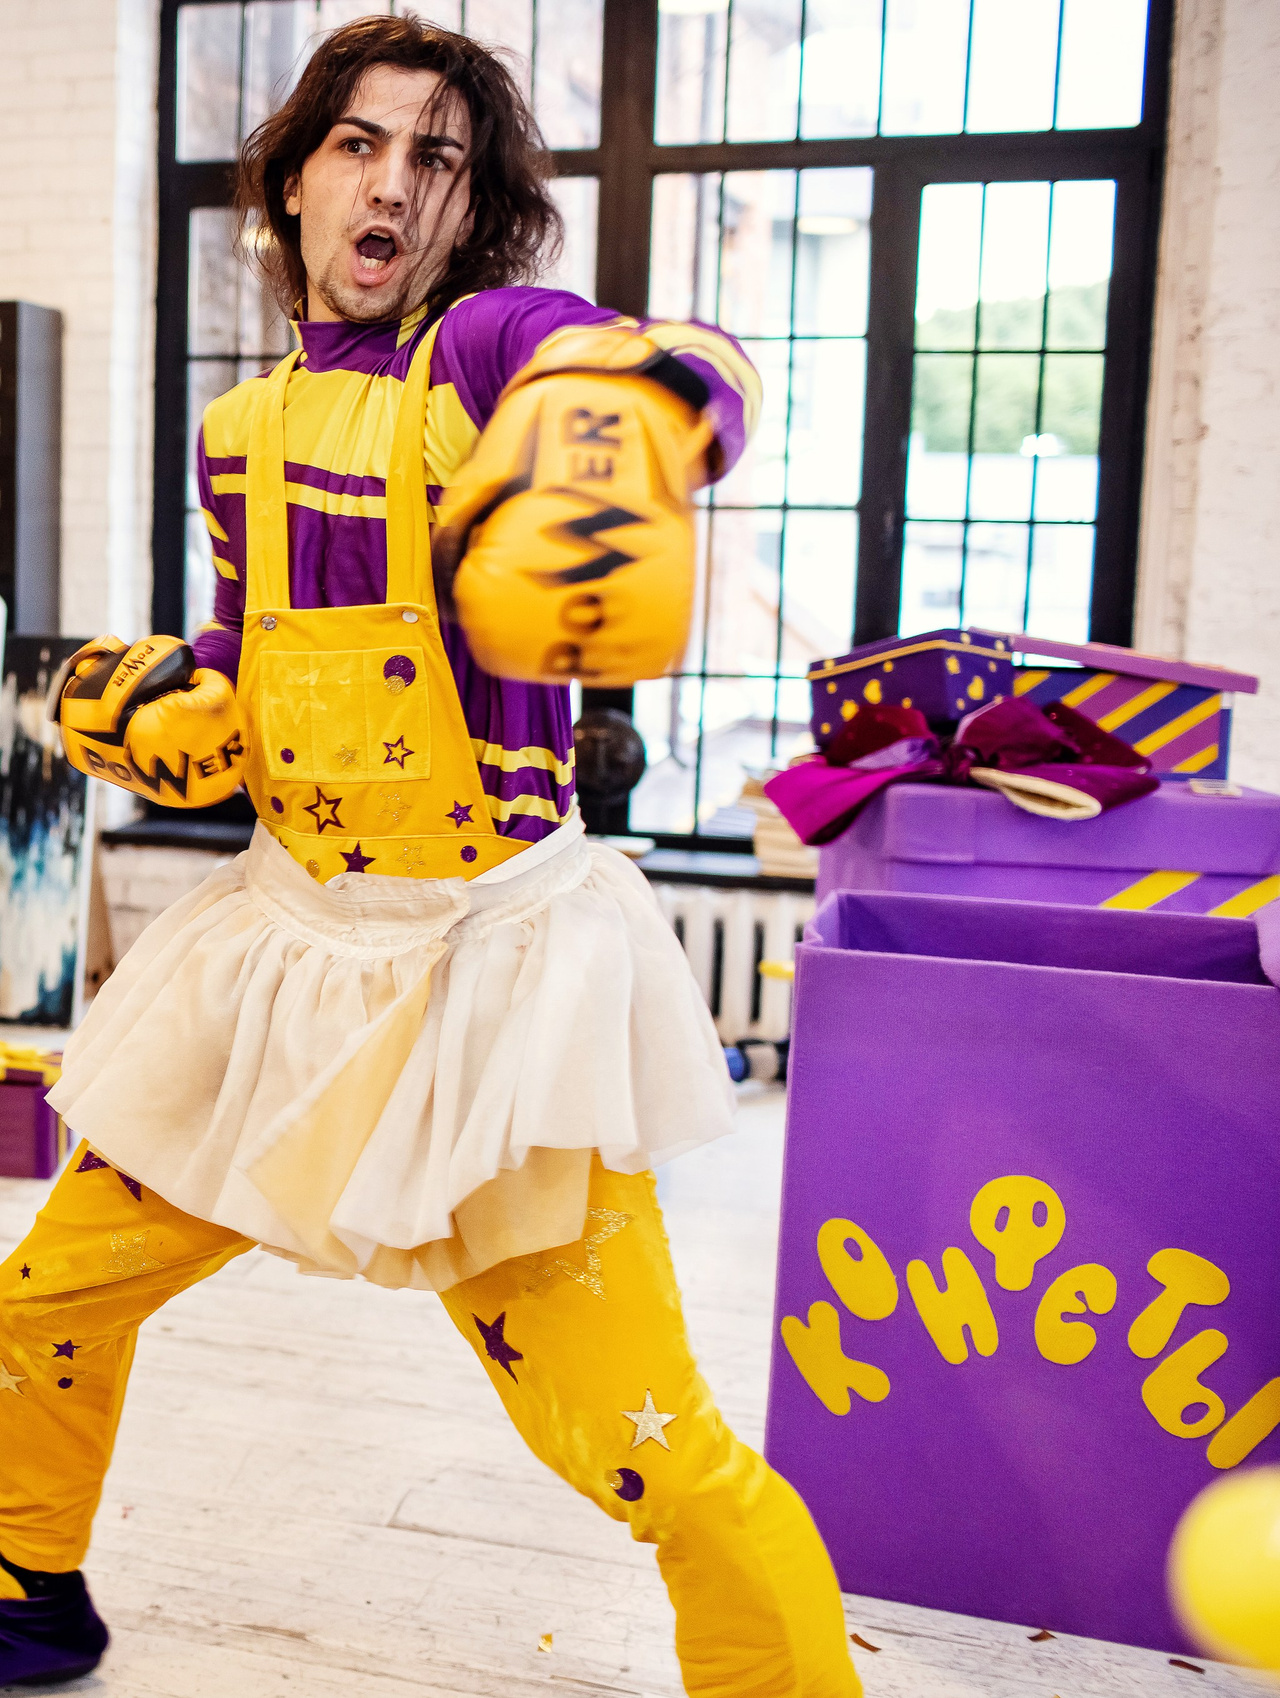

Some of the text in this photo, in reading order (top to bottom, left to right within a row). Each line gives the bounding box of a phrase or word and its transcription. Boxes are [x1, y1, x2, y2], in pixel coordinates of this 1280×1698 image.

[526, 406, 652, 677] POWER
[112, 644, 155, 687] POWER
[79, 729, 244, 803] POWER
[780, 1175, 1280, 1469] КОНФЕТЫ
